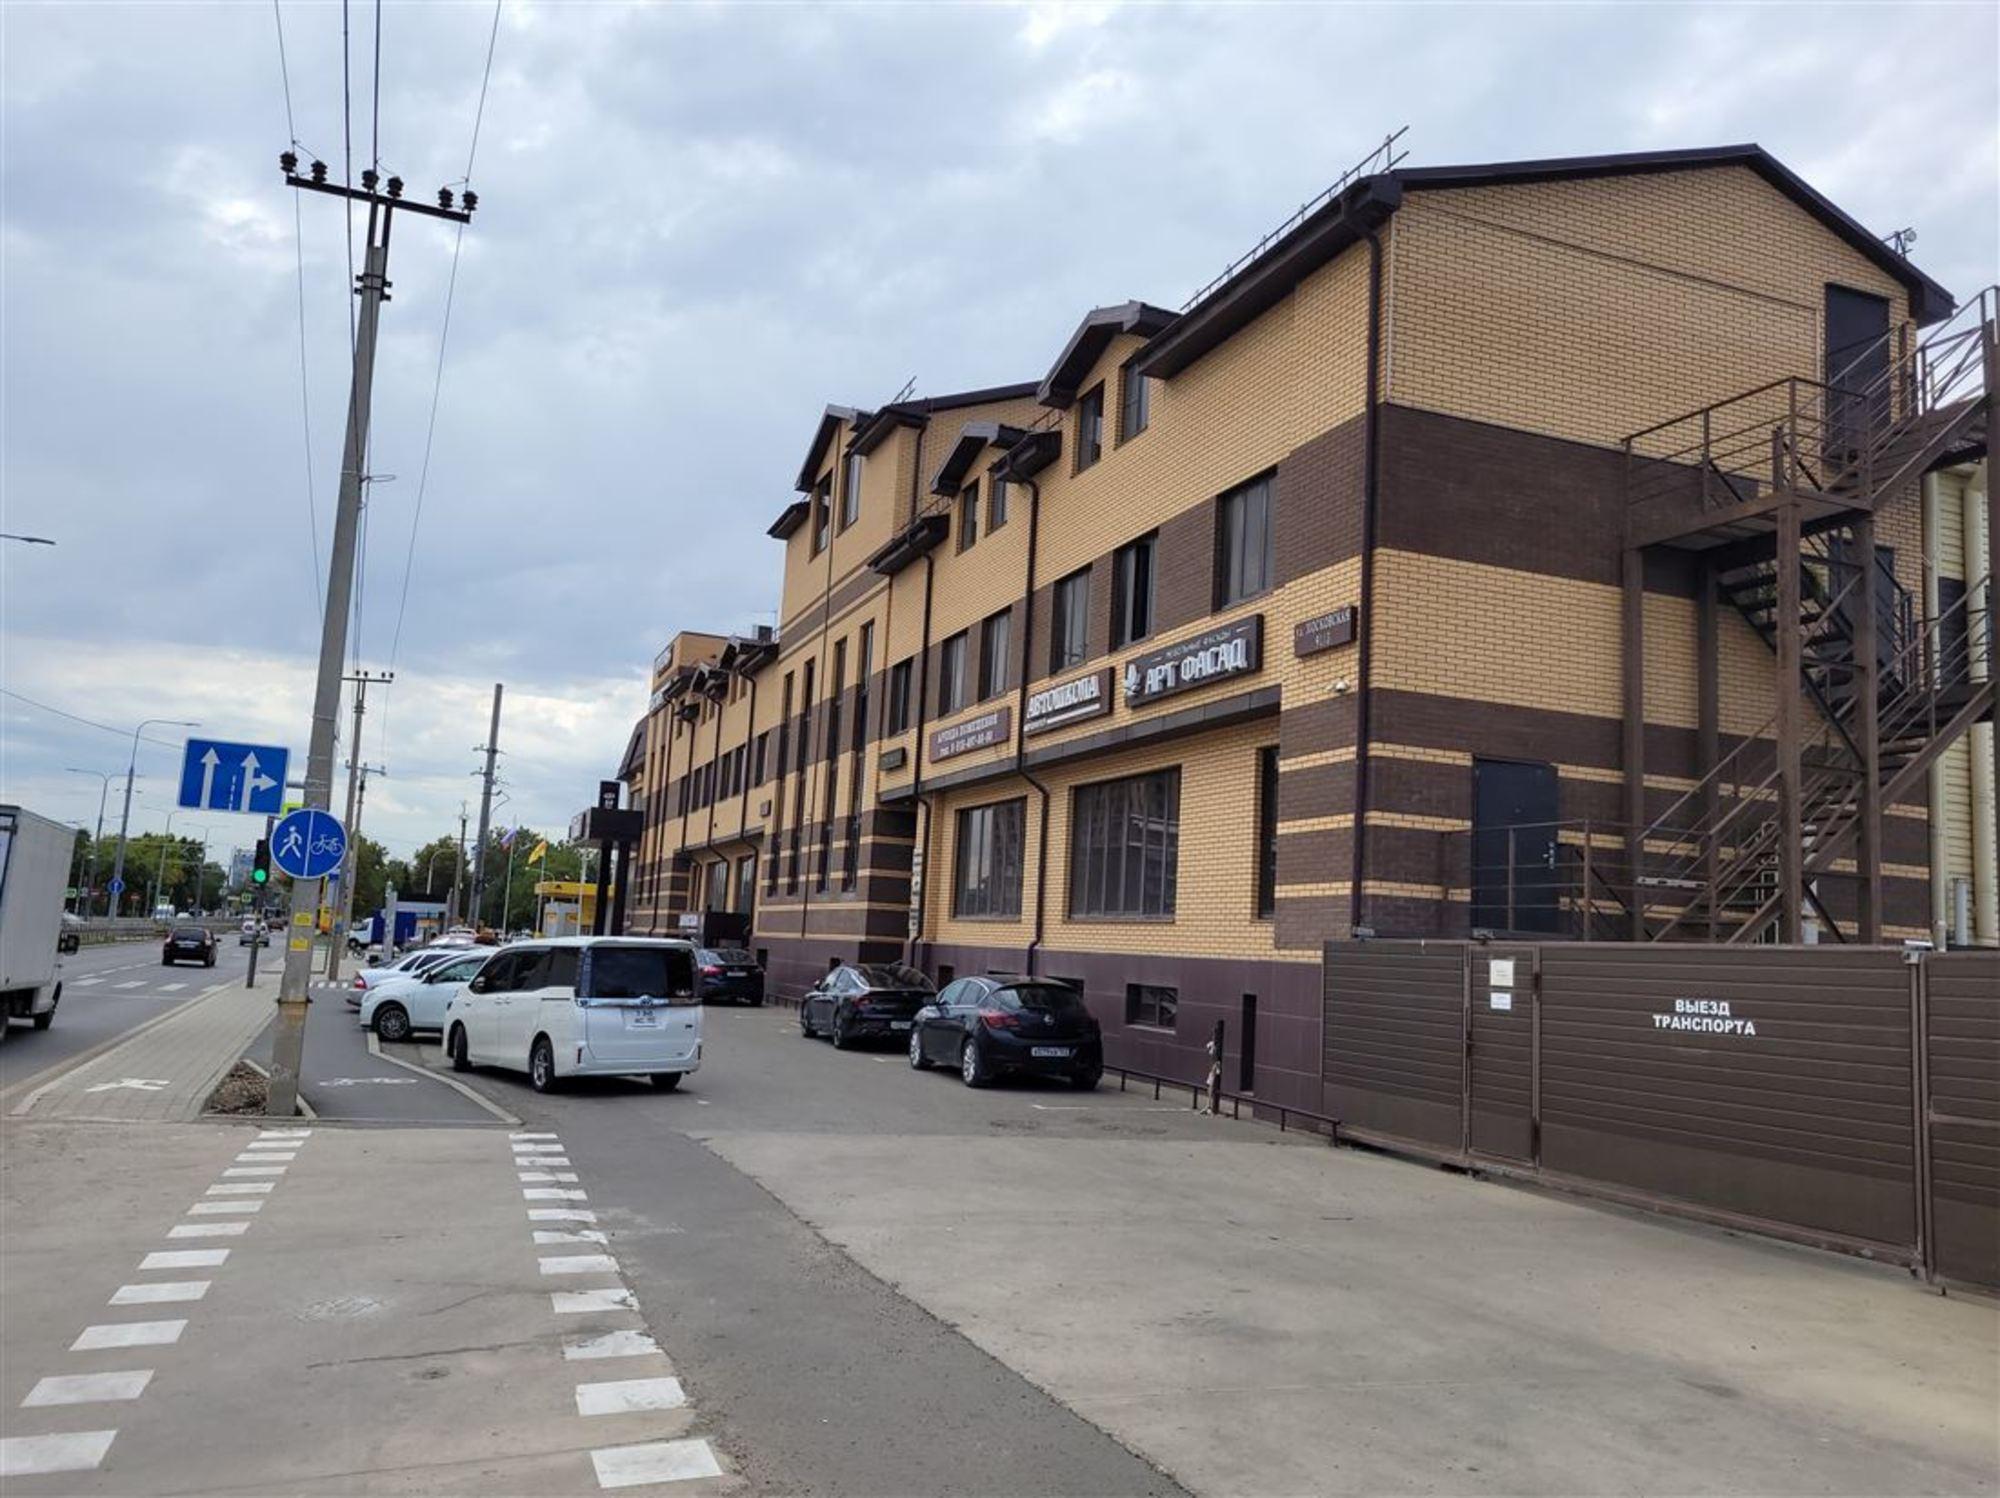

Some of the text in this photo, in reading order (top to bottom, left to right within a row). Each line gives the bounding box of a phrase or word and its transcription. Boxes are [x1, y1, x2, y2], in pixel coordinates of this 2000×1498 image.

[1145, 661, 1179, 694] АРТ
[1181, 638, 1248, 681] ФАСАД
[1027, 675, 1100, 718] АВТОШКОЛА
[1675, 999, 1730, 1017] ВЫЕЗД
[1653, 1014, 1756, 1036] ТРАНСПОРТА
